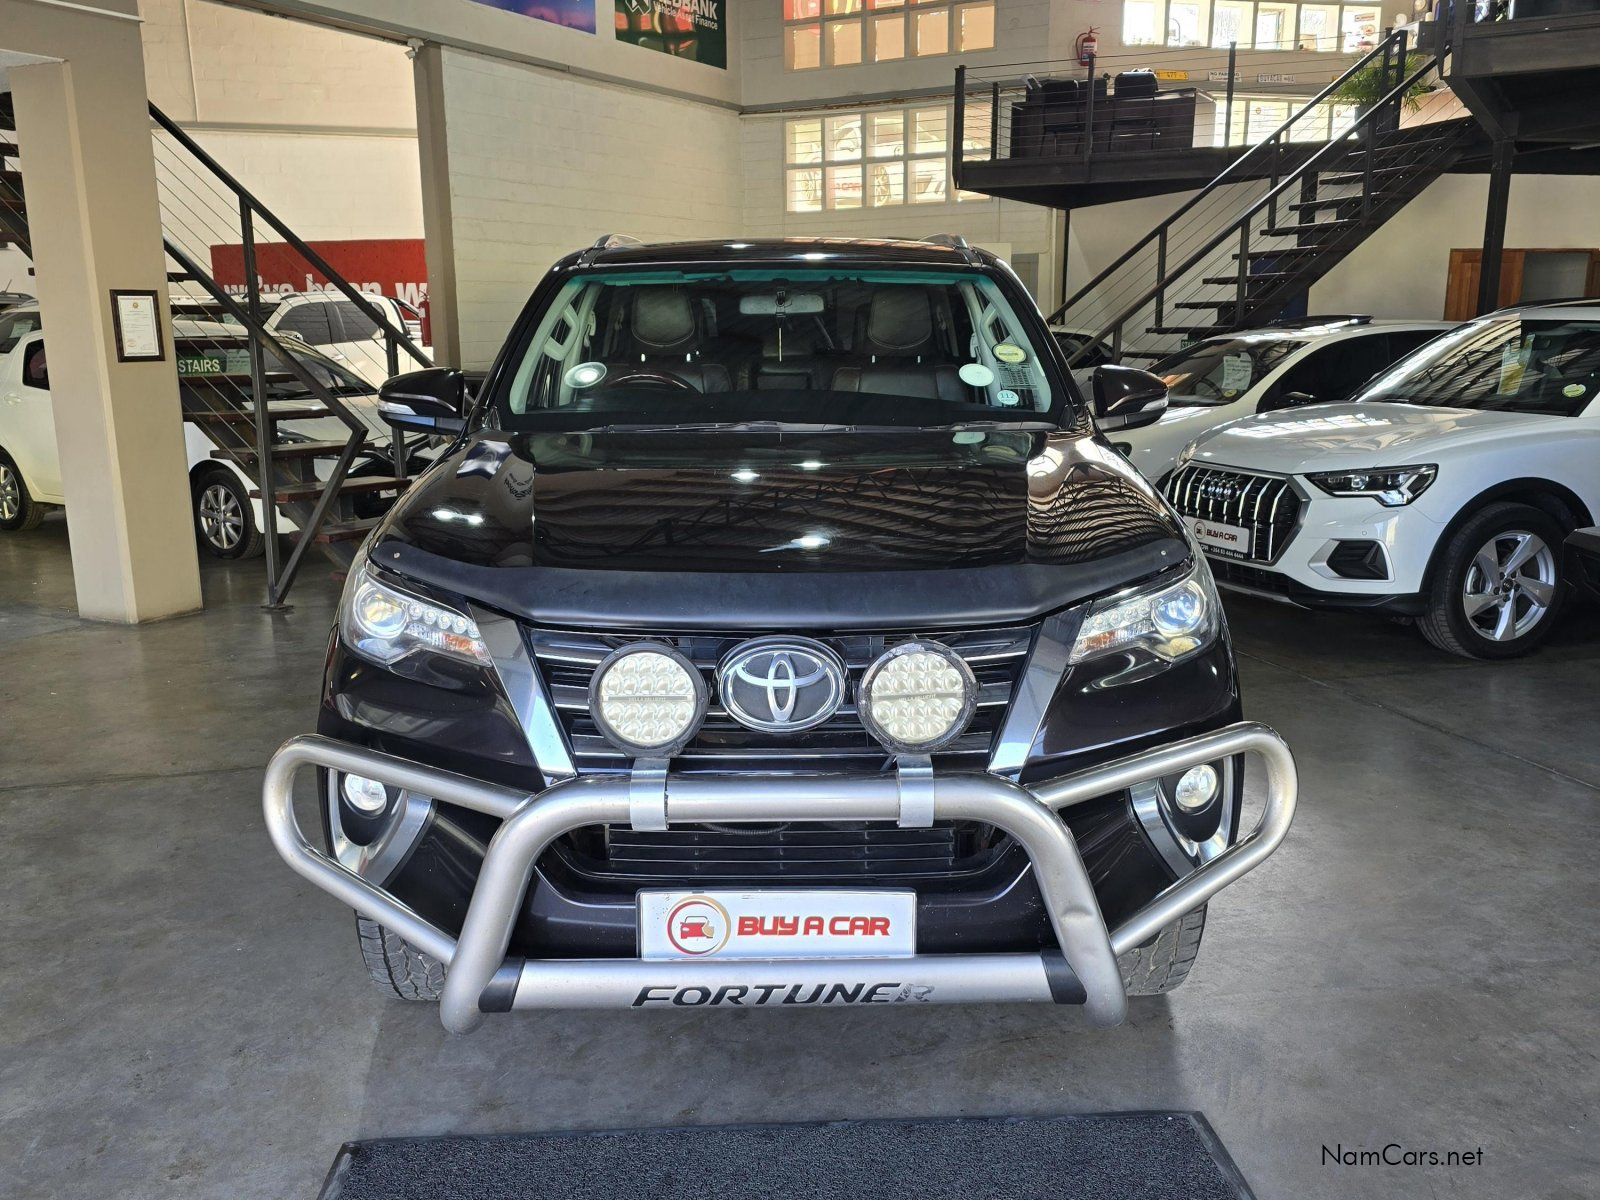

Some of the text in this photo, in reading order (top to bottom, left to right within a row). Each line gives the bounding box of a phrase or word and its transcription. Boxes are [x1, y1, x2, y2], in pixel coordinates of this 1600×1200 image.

[653, 1, 677, 17] Vehicle
[695, 15, 719, 30] Finance
[658, 0, 718, 20] DBANK
[178, 359, 220, 373] STAIRS
[1206, 529, 1218, 538] BUY
[1224, 533, 1238, 542] CAR
[737, 915, 890, 936] BUY A CAR
[631, 982, 935, 1007] FORTUNER
